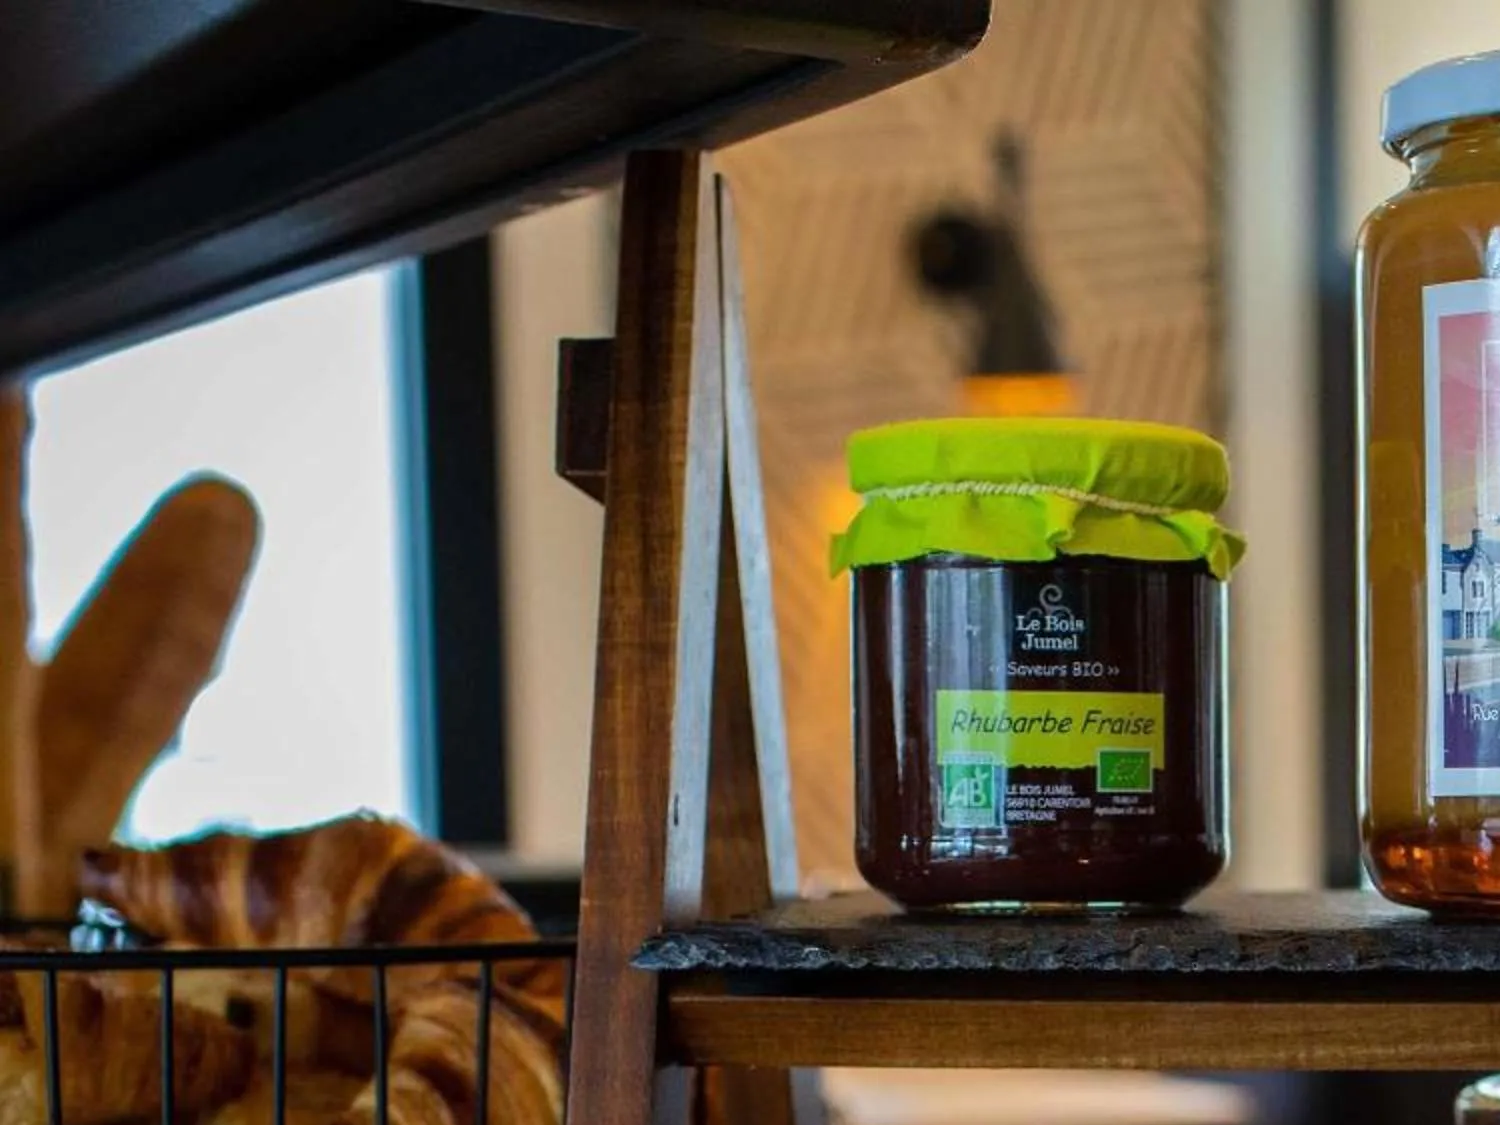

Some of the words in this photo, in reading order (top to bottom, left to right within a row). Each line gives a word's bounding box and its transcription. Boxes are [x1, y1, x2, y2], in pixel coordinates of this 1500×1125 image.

[1015, 615, 1040, 631] Le
[1043, 615, 1085, 632] Bois
[1021, 633, 1079, 650] Jumel
[1007, 661, 1068, 677] Saveurs
[1072, 661, 1104, 677] BIO
[1471, 703, 1499, 721] Rue
[951, 709, 1072, 734] Rhubarbe
[1080, 710, 1156, 735] Fraise
